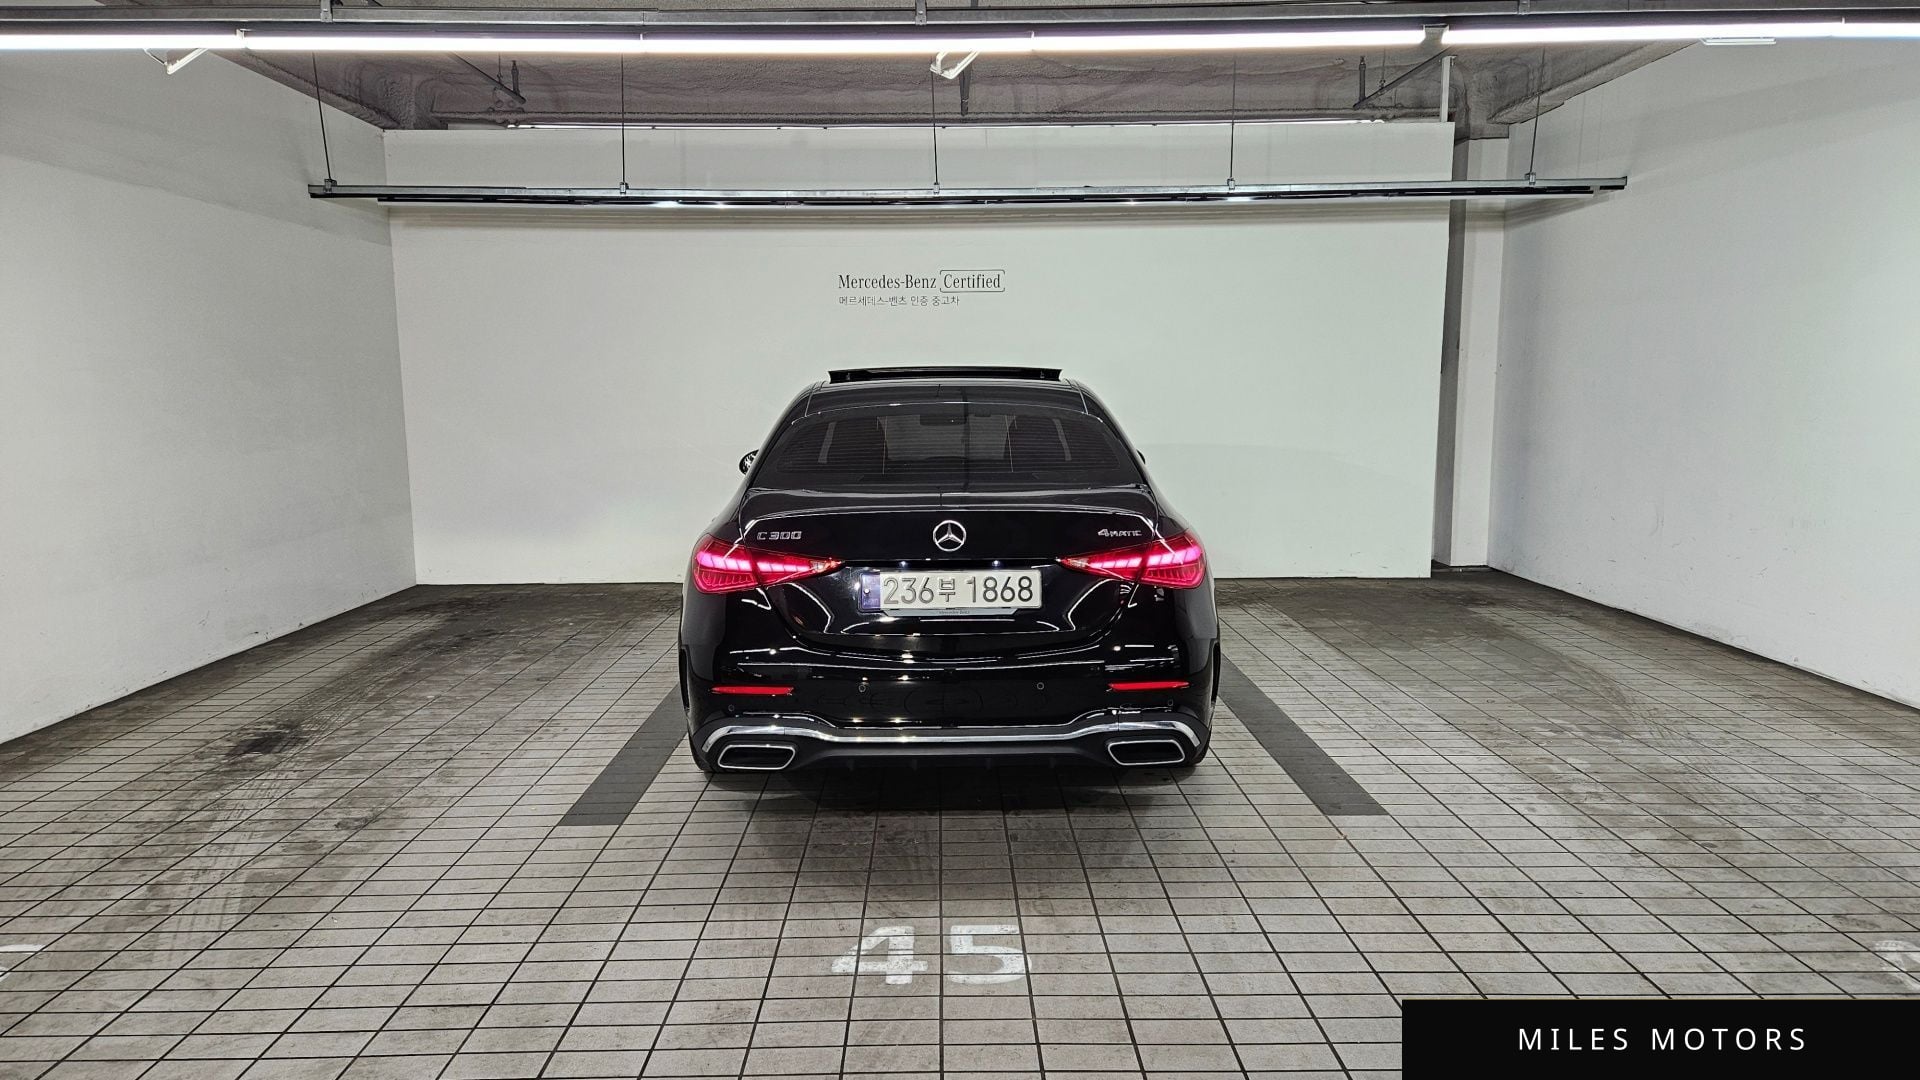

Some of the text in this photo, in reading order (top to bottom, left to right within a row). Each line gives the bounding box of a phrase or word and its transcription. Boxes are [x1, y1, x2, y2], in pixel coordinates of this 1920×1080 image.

[838, 274, 1001, 289] Mercedes-Benz Certified
[838, 295, 960, 307] 메르세데스-벤츠 인증 중고차
[756, 530, 802, 541] C 300
[883, 575, 1033, 605] 236부 1868
[831, 924, 1032, 985] 45
